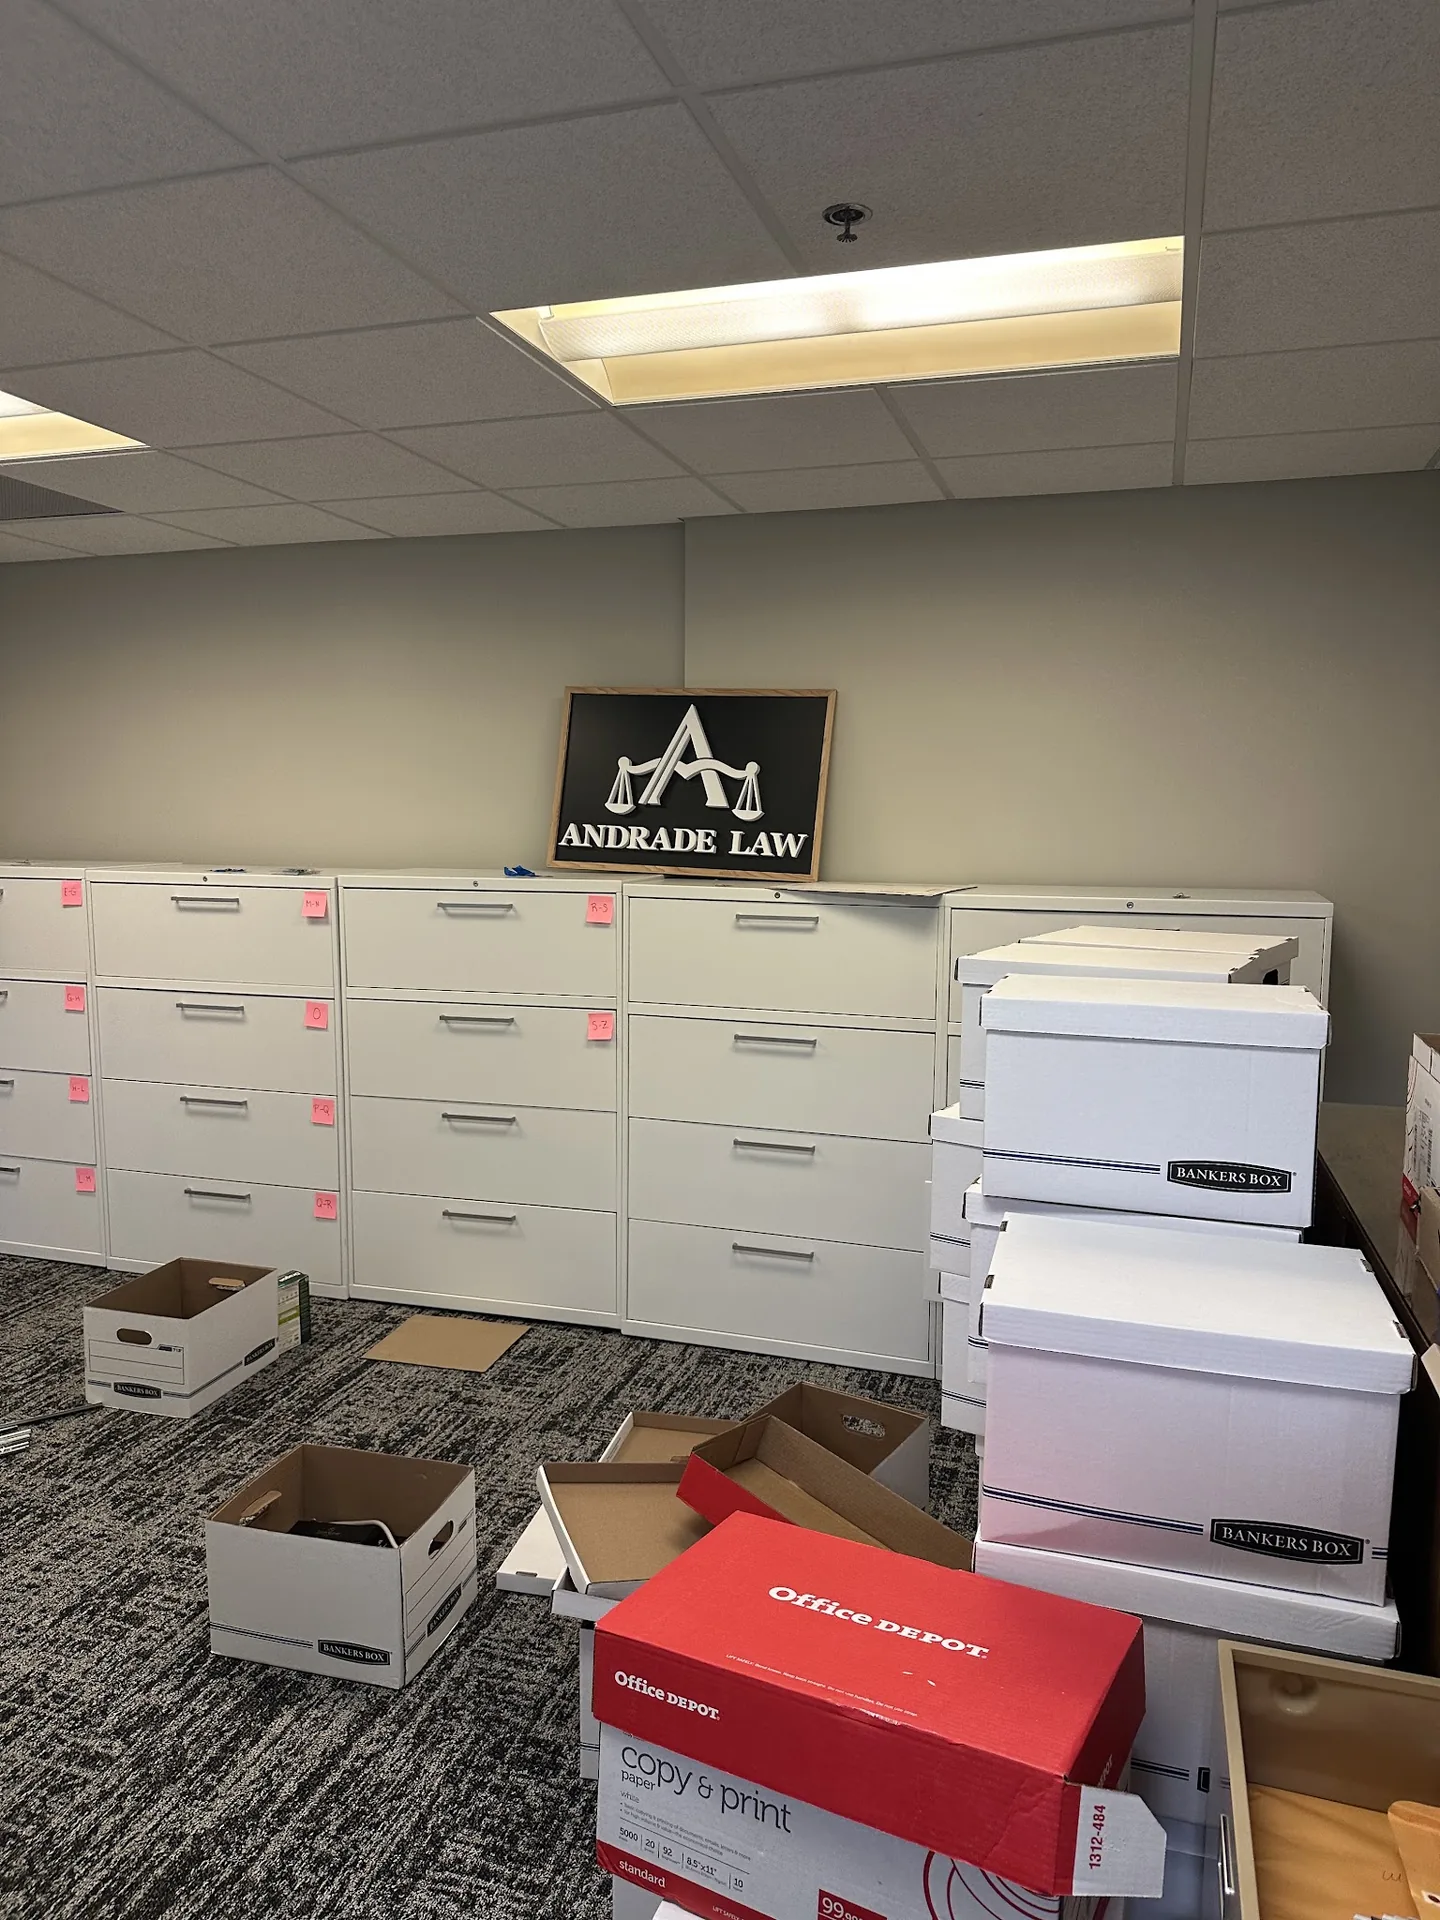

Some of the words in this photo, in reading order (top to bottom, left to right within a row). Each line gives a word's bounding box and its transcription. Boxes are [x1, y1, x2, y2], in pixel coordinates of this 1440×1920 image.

[558, 823, 717, 853] ANDRADE
[728, 830, 808, 858] LAW
[590, 902, 609, 913] R-S
[592, 1020, 609, 1031] S-Z
[313, 1104, 330, 1116] P-Q
[1176, 1166, 1246, 1184] BANKERS
[1249, 1173, 1282, 1187] BOX
[316, 1197, 333, 1209] Q-R
[117, 1384, 145, 1395] BANKERS
[145, 1388, 159, 1397] BOX
[1222, 1526, 1308, 1552] BANKERS
[1312, 1539, 1353, 1557] BOX
[768, 1586, 873, 1626] Office
[874, 1618, 989, 1659] DEPOT
[323, 1643, 364, 1659] BANKERS
[365, 1650, 385, 1662] BOX
[614, 1671, 665, 1701] Office
[666, 1692, 720, 1720] DEPOT
[621, 1769, 656, 1791] paper
[621, 1746, 693, 1795] copy
[698, 1775, 714, 1799] &
[720, 1785, 792, 1834] print
[620, 1790, 640, 1803] white
[1088, 1804, 1106, 1869] 1312-484
[619, 1827, 639, 1842] 5000
[645, 1838, 656, 1850] 20
[662, 1846, 673, 1857] 92
[733, 1877, 744, 1888] 10
[618, 1859, 666, 1889] standard
